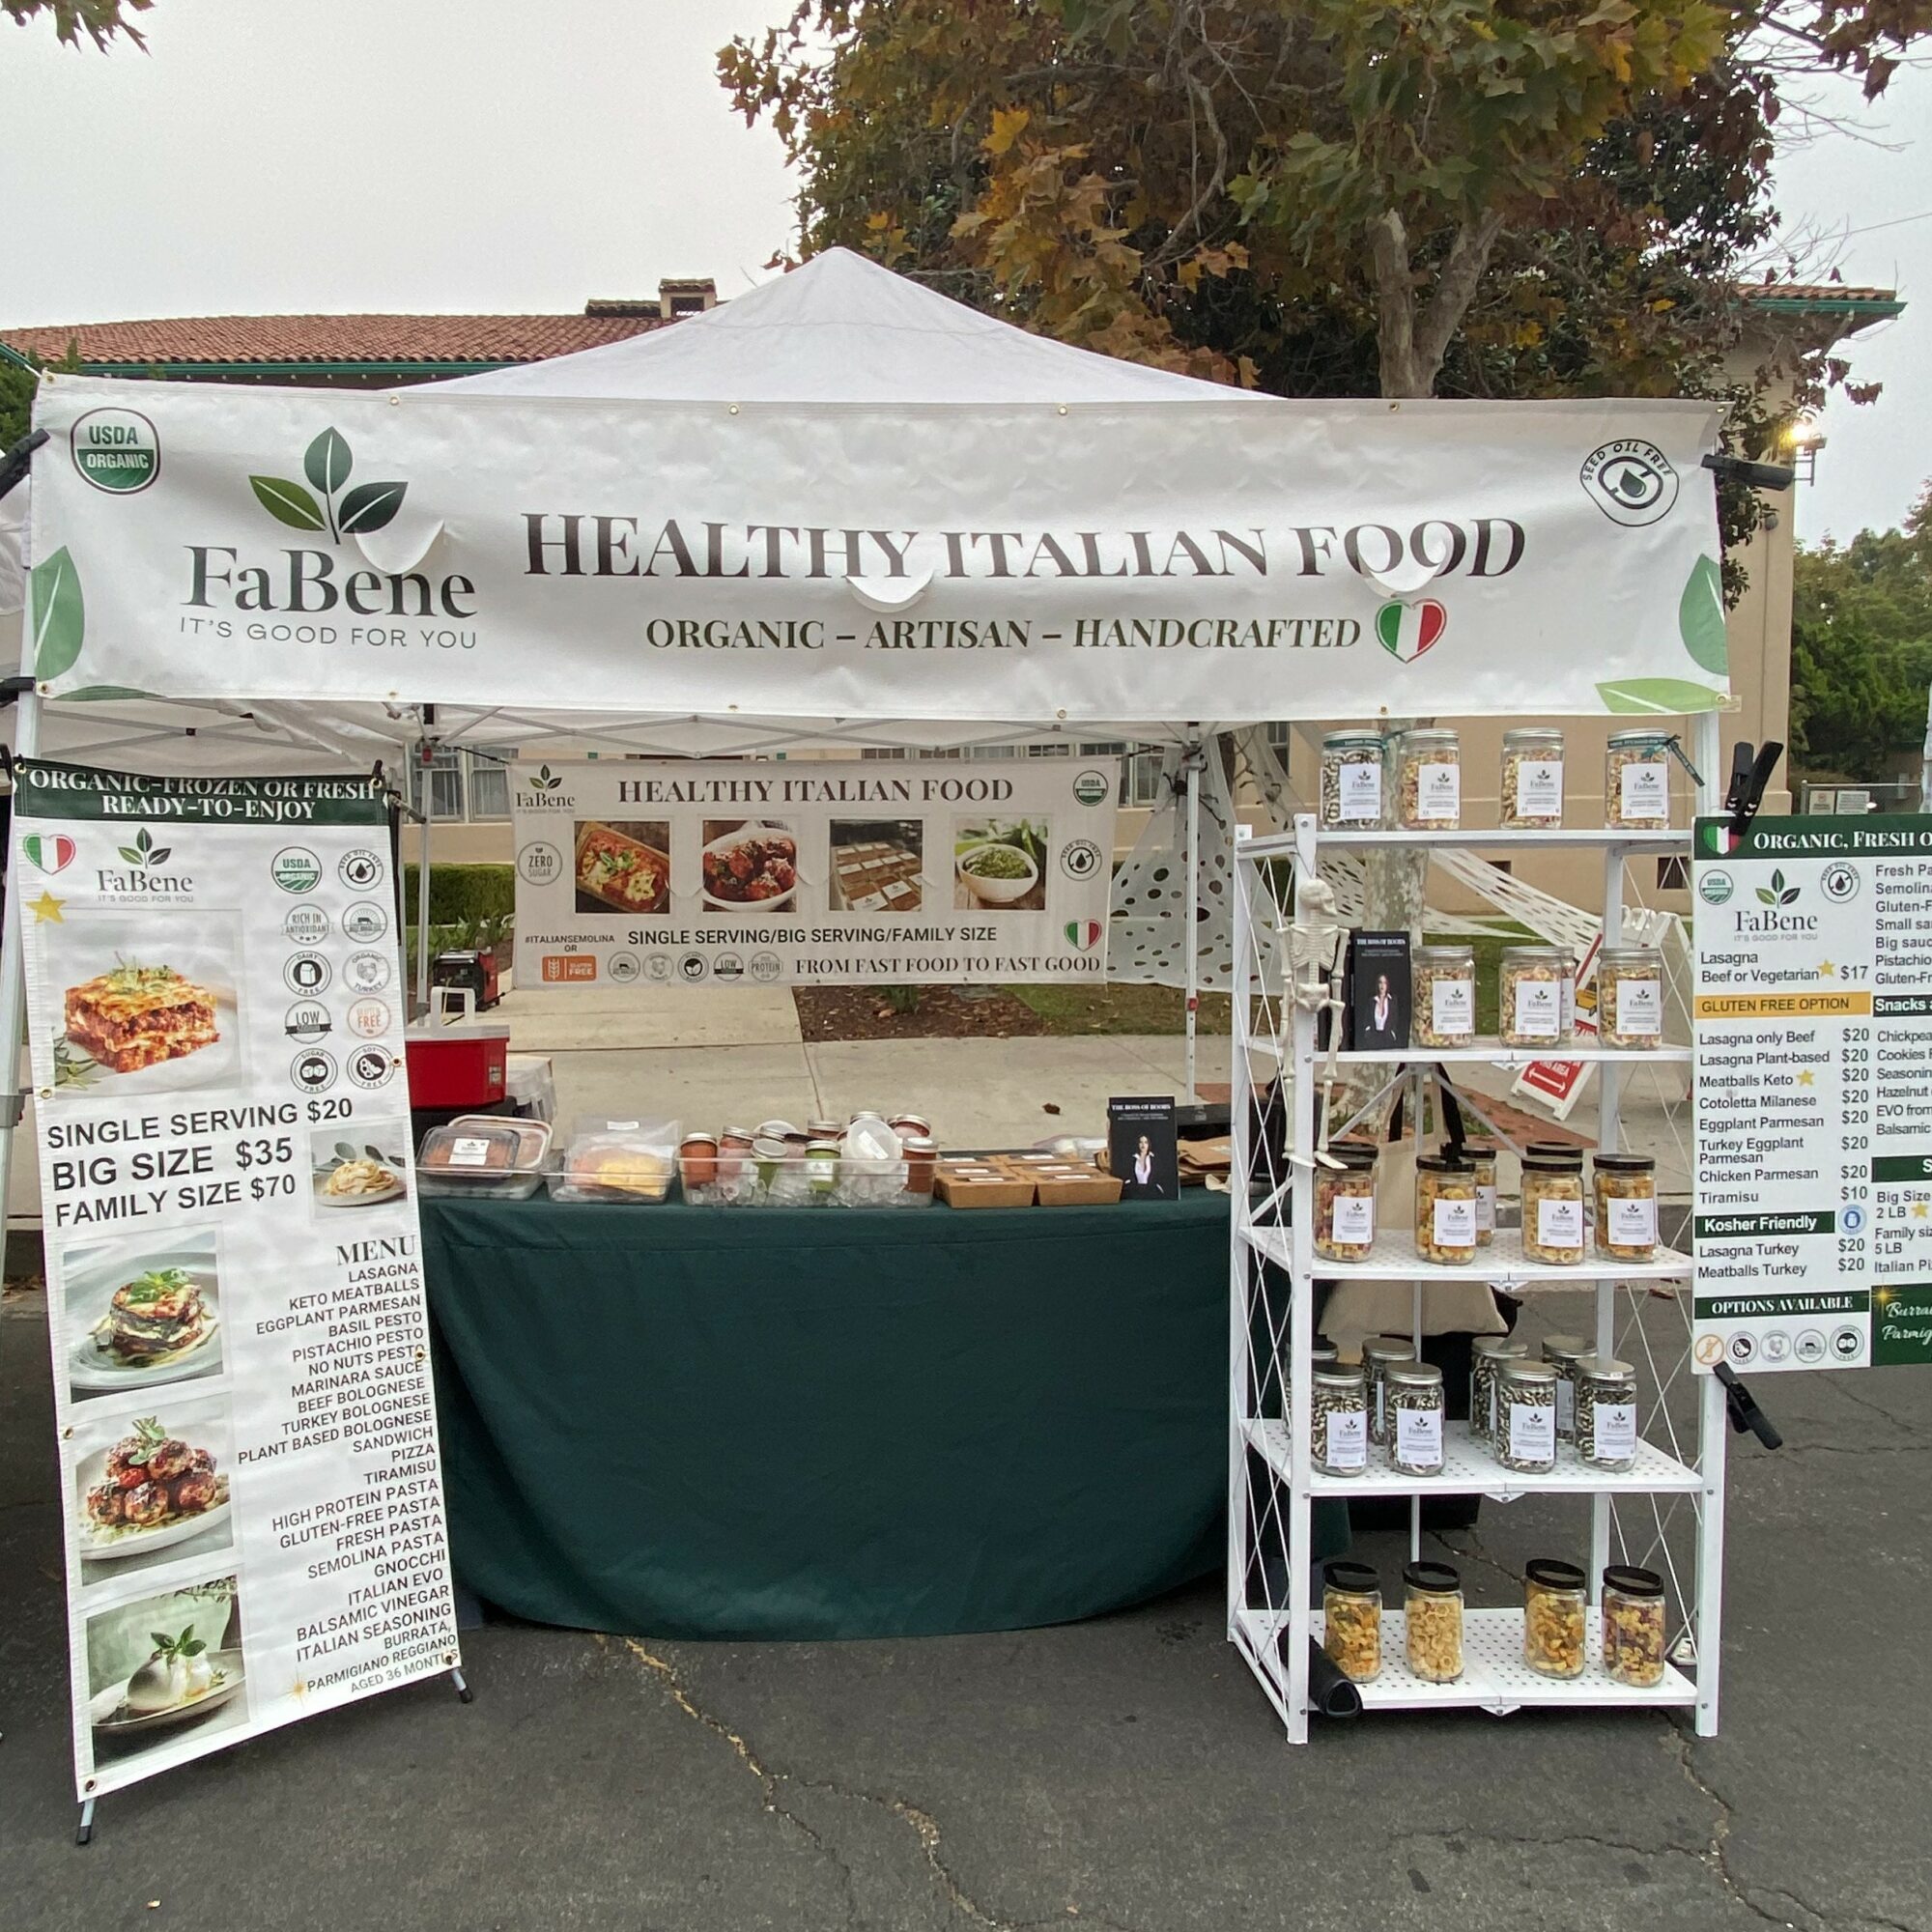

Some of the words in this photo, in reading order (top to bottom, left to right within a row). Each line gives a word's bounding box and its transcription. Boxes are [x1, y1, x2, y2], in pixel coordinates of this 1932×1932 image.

[89, 426, 138, 444] USDA
[87, 453, 149, 469] ORGANIC
[1583, 451, 1605, 480] SEED
[1613, 442, 1639, 452] OIL
[1644, 449, 1674, 475] FREE
[521, 513, 918, 579] HEALTHY
[940, 528, 1268, 579] ITALIAN
[1288, 518, 1526, 580] FOOD
[181, 545, 477, 618] FaBene
[181, 617, 232, 638] IT'S
[247, 624, 336, 644] GOOD
[352, 628, 407, 647] FOR
[421, 631, 476, 649] YOU
[646, 618, 825, 649] ORGANIC
[864, 619, 1033, 649] ARTISAN
[1073, 618, 1361, 648] HANDCRAFTED
[29, 769, 260, 798] ORGANIC-FROZEN
[265, 781, 298, 798] OR
[303, 781, 375, 800] FRESH
[618, 781, 773, 803] HEALTHY
[783, 780, 912, 802] ITALIAN
[922, 779, 1013, 802] FOOD
[102, 796, 316, 822] READY-TO-ENJOY
[516, 792, 576, 807] FaBene
[1753, 832, 1848, 850] ORGANIC,
[1854, 831, 1915, 847] FRESH
[282, 859, 311, 868] USDA
[528, 856, 553, 867] ZERO
[97, 869, 193, 893] FaBene
[292, 913, 309, 923] RICH
[313, 913, 321, 923] IN
[1734, 910, 1817, 932] FaBene
[628, 930, 690, 945] SINGLE
[696, 929, 806, 944] SERVING/BIG
[811, 927, 955, 943] SERVING/FAMILY
[960, 927, 997, 942] SIZE
[297, 952, 317, 961] DAIRY
[796, 958, 849, 974] FROM
[856, 958, 901, 973] FAST
[906, 957, 958, 972] FOOD
[966, 957, 991, 972] TO
[996, 957, 1040, 972] FAST
[1044, 957, 1099, 972] GOOD
[1700, 952, 1758, 966] Lasagna
[1701, 969, 1732, 982] Beef
[1734, 972, 1747, 981] or
[1750, 968, 1819, 984] Vegetarian
[1840, 965, 1868, 980] $17
[1701, 1000, 1756, 1012] GLUTEN
[1760, 998, 1795, 1010] FREE
[1800, 997, 1849, 1009] OPTION
[296, 1010, 320, 1025] LOW
[1699, 1033, 1752, 1047] Lasagna
[1756, 1032, 1782, 1046] only
[1786, 1030, 1815, 1043] Beef
[1842, 1028, 1869, 1042] $20
[1699, 1053, 1752, 1067] Lasagna
[1756, 1050, 1830, 1064] Plant-based
[1841, 1048, 1868, 1062] $20
[1699, 1073, 1760, 1088] Meatballs
[1763, 1073, 1793, 1086] Keto
[1841, 1067, 1868, 1082] $20
[1699, 1095, 1756, 1110] Cotoletta
[1760, 1094, 1816, 1107] Milanese
[1841, 1090, 1868, 1104] $20
[46, 1117, 160, 1149] SINGLE
[170, 1102, 298, 1136] SERVING
[307, 1097, 353, 1122] $20
[1699, 1117, 1756, 1133] Eggplant
[1760, 1115, 1824, 1128] Parmesan
[1841, 1110, 1868, 1124] $20
[1699, 1138, 1743, 1152] Turkey
[1747, 1136, 1804, 1151] Eggplant
[1841, 1136, 1868, 1151] $20
[53, 1157, 117, 1192] BIG
[131, 1146, 213, 1181] SIZE
[236, 1137, 293, 1170] $35
[1699, 1152, 1763, 1165] Parmesan
[1699, 1170, 1751, 1182] Chicken
[1754, 1168, 1818, 1180] Parmesan
[1840, 1165, 1867, 1179] $20
[56, 1191, 169, 1227] FAMILY
[178, 1180, 242, 1209] SIZE
[251, 1174, 296, 1201] $70
[1699, 1191, 1759, 1205] Tiramisu
[1840, 1185, 1867, 1201] $10
[1877, 1191, 1899, 1205] Big
[1903, 1190, 1930, 1202] Size
[1704, 1216, 1756, 1233] Kosher
[1759, 1215, 1817, 1232] Friendly
[1877, 1208, 1884, 1219] 2
[1889, 1207, 1906, 1218] LB
[336, 1235, 415, 1266] MENU
[1699, 1245, 1752, 1260] Lasagna
[1755, 1242, 1799, 1257] Turkey
[1838, 1237, 1865, 1252] $20
[1875, 1243, 1883, 1255] 5
[1886, 1242, 1902, 1254] LB
[349, 1262, 418, 1283] LASAGNA
[1698, 1264, 1759, 1278] Meatballs
[1762, 1264, 1806, 1277] Turkey
[1838, 1257, 1865, 1271] $20
[289, 1293, 327, 1311] KETO
[332, 1278, 420, 1303] MEATBALLS
[1712, 1299, 1775, 1315] OPTIONS
[1776, 1296, 1854, 1312] AVAILABLE
[256, 1309, 334, 1335] EGGPLANT
[339, 1294, 421, 1320] PARMESAN
[328, 1319, 371, 1337] BASIL
[375, 1311, 422, 1329] PESTO
[293, 1335, 372, 1362] PISTACHIO
[376, 1327, 424, 1346] PESTO
[308, 1361, 329, 1377] NO
[333, 1352, 374, 1372] NUTS
[291, 1370, 371, 1398] MARINARA
[375, 1360, 424, 1379] SAUCE
[298, 1395, 333, 1413] BEEF
[337, 1377, 425, 1405] BOLOGNESE
[282, 1411, 338, 1435] TURKEY
[342, 1392, 431, 1420] BOLOGNESE
[239, 1440, 288, 1464] PLANT
[293, 1429, 339, 1451] BASED
[343, 1409, 432, 1437] BOLOGNESE
[353, 1426, 433, 1453] SANDWICH
[391, 1443, 435, 1463] PIZZA
[363, 1460, 437, 1485] TIRAMISU
[271, 1509, 311, 1532] HIGH
[316, 1489, 381, 1520] PROTEIN
[386, 1478, 439, 1499] PASTA
[280, 1510, 383, 1548] GLUTEN-FREE
[388, 1496, 440, 1519] PASTA
[337, 1528, 385, 1551] FRESH
[390, 1514, 442, 1536] PASTA
[307, 1548, 386, 1579] SEMOLINA
[392, 1531, 443, 1555] PASTA
[374, 1548, 446, 1577] GNOCCHI
[348, 1577, 408, 1606] ITALIAN
[412, 1568, 442, 1587] EVO
[297, 1605, 378, 1642] BALSAMIC
[381, 1584, 449, 1614] VINEGAR
[297, 1631, 358, 1662] ITALIAN
[363, 1603, 451, 1640] SEASONING
[384, 1621, 451, 1650] BURRATA,
[307, 1655, 389, 1692] PARMIGIANO
[392, 1634, 456, 1665] REGGIANO
